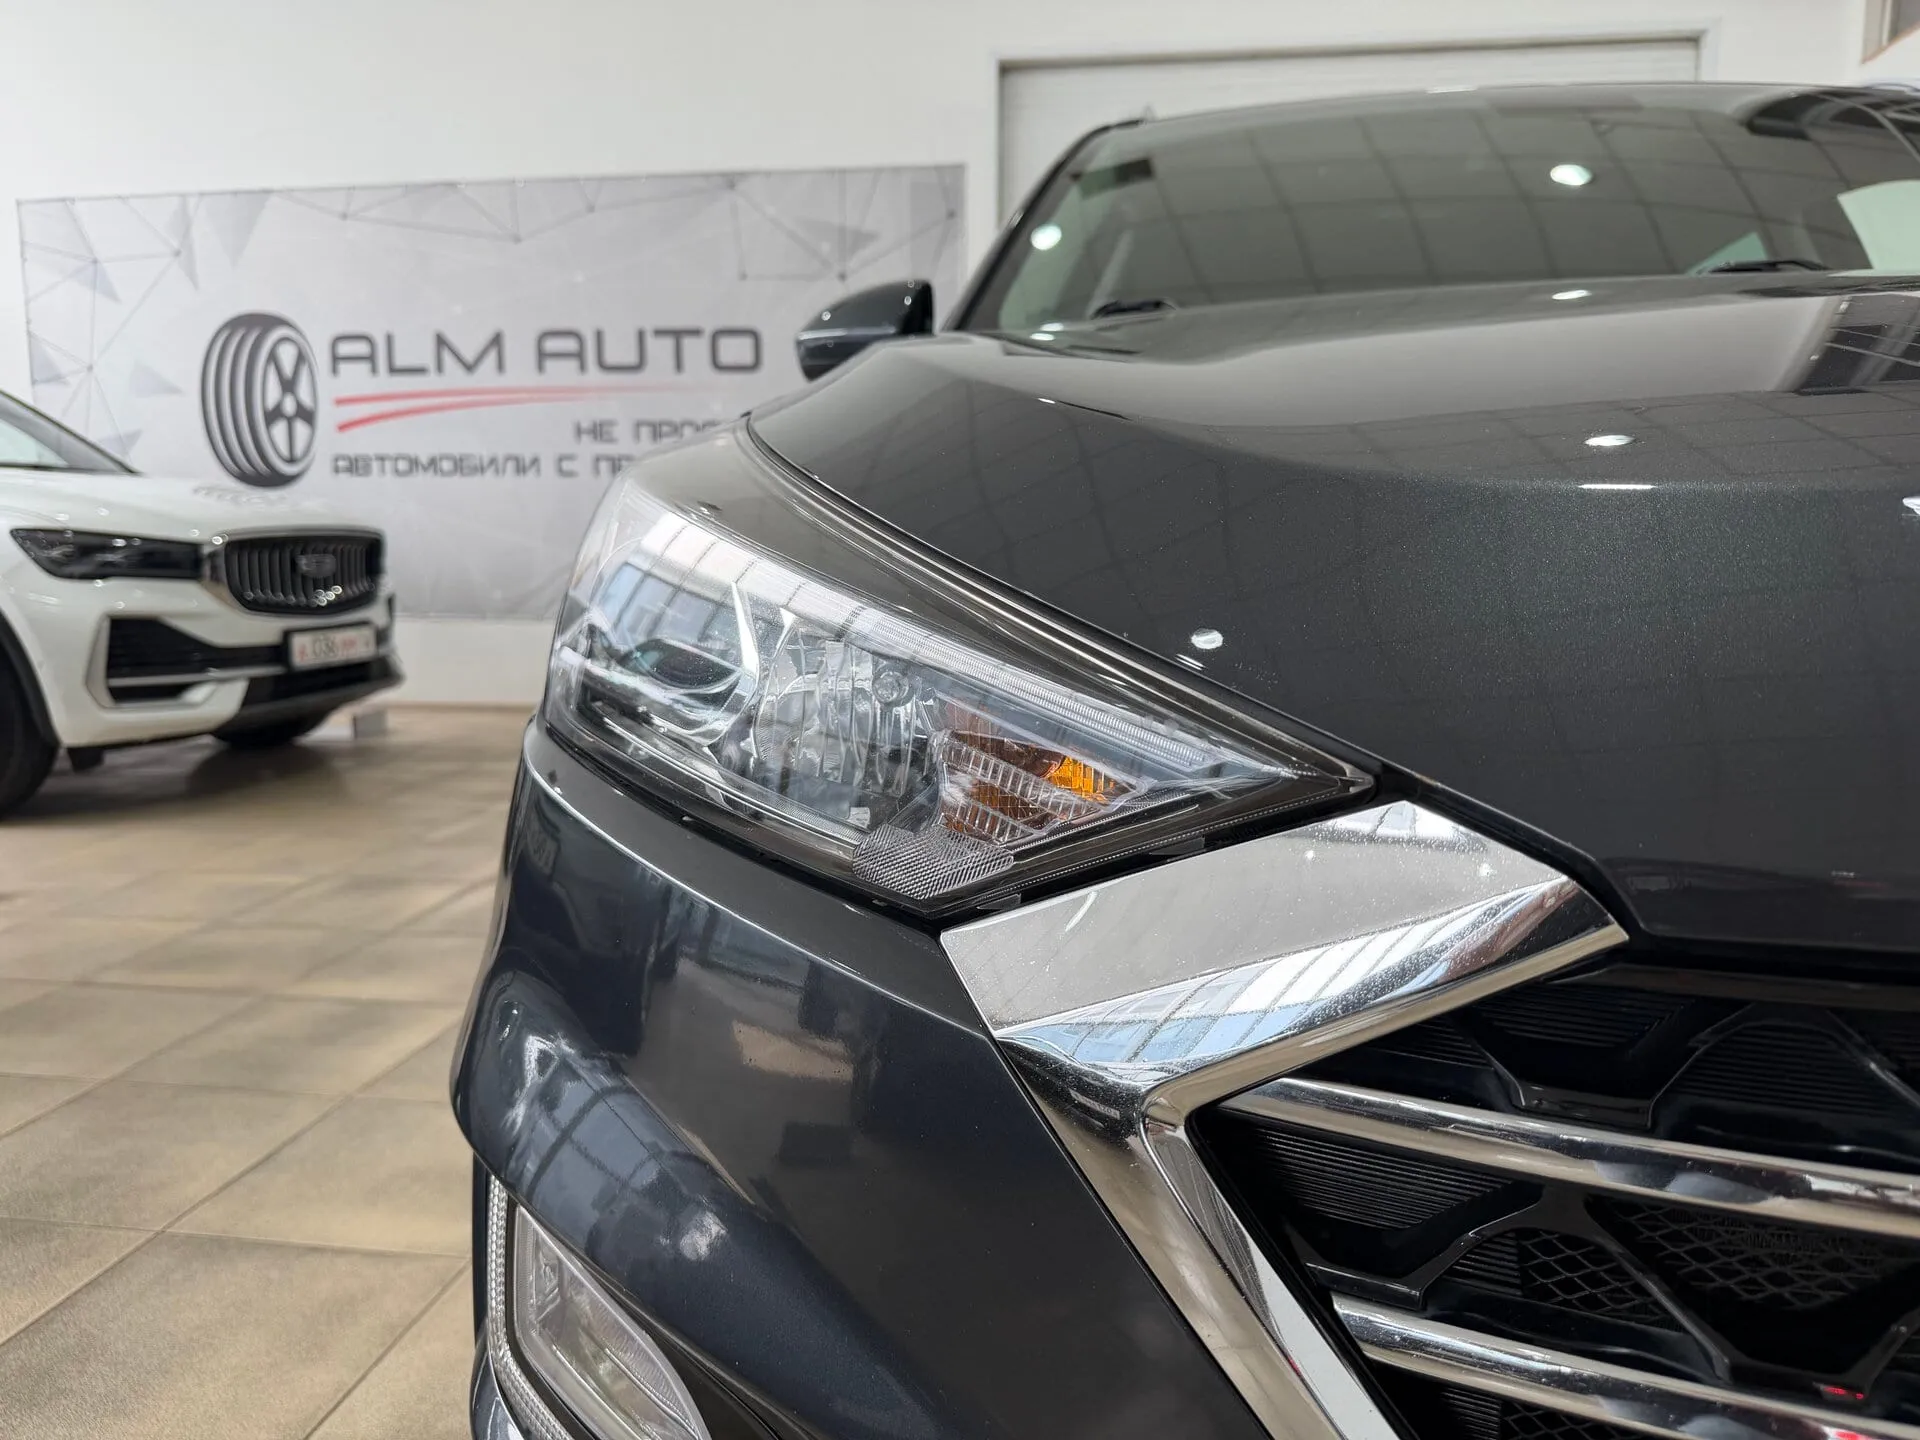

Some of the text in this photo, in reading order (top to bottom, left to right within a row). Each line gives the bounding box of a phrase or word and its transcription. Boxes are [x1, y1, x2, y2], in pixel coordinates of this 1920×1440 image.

[330, 328, 762, 376] ALM AUTO
[574, 419, 617, 445] НЕ
[332, 455, 540, 478] АВТОМОБИЛИ
[556, 453, 578, 478] С
